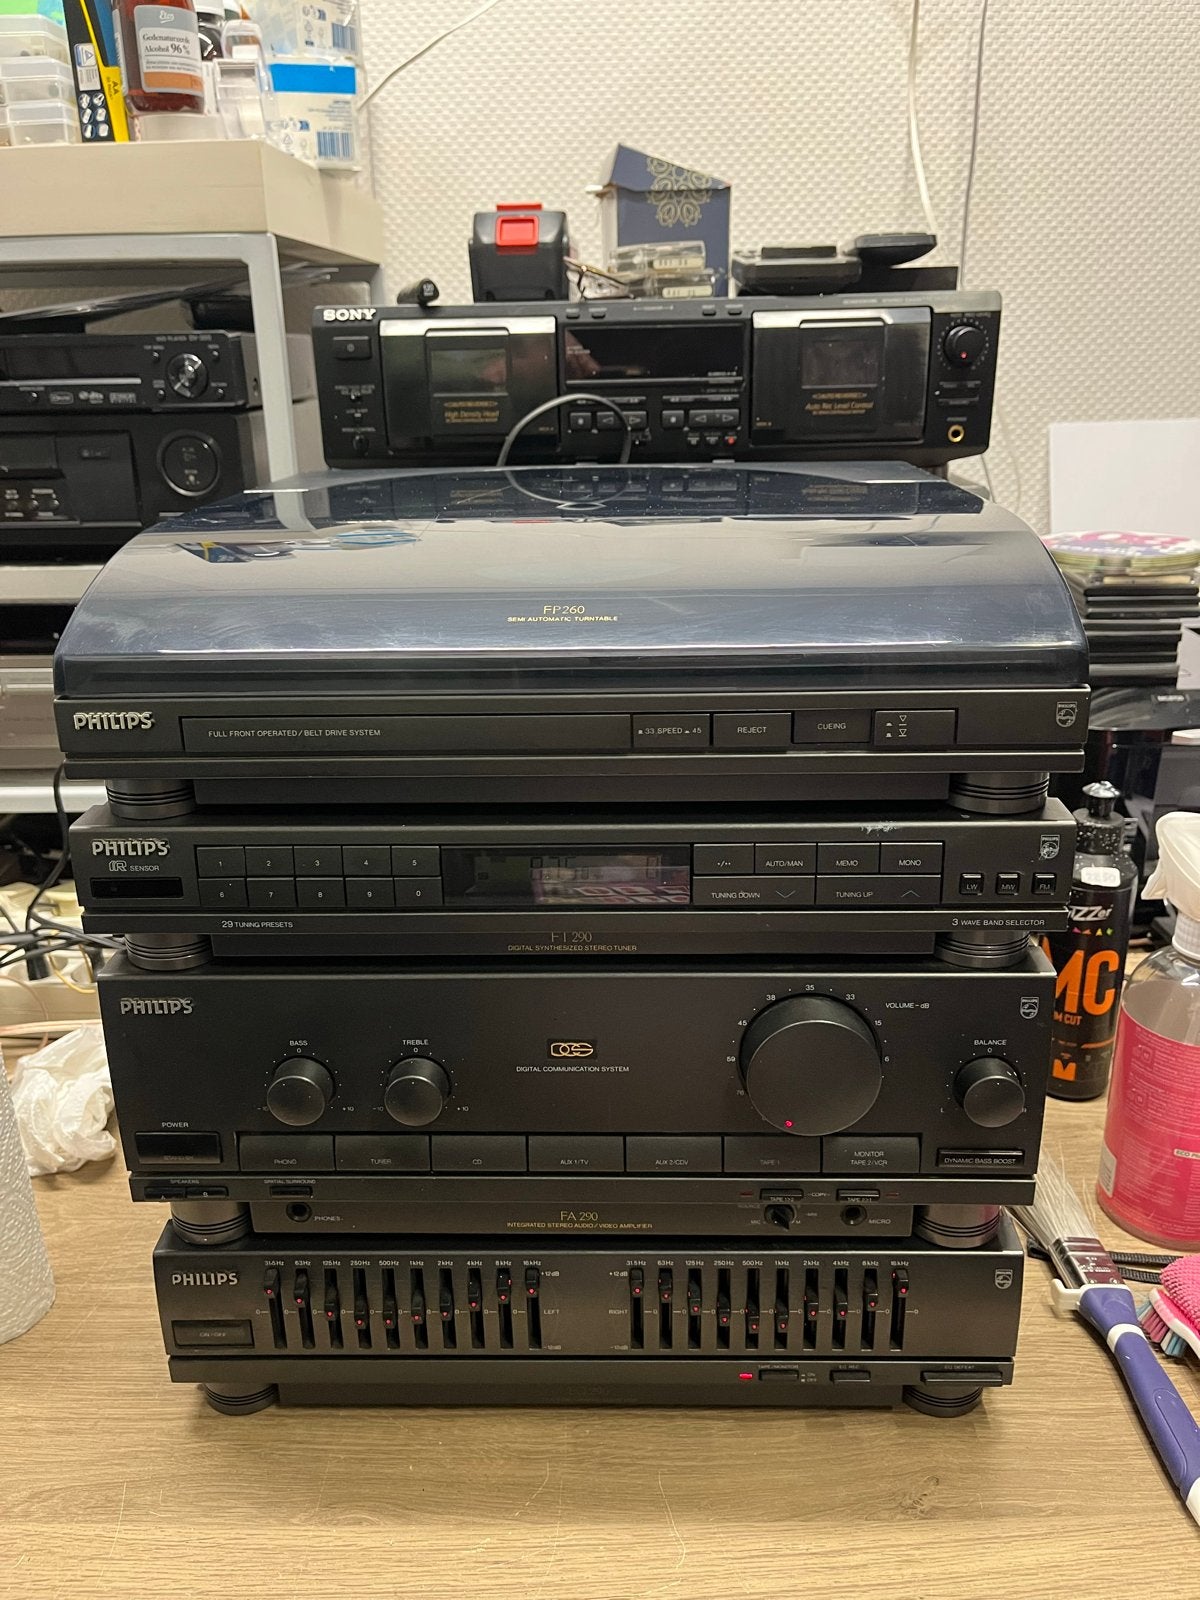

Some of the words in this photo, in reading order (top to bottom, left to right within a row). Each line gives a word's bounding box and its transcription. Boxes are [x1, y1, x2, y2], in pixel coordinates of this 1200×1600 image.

[145, 45, 169, 53] Alcohol
[323, 309, 376, 321] SONY
[543, 605, 585, 615] FP260
[73, 712, 152, 730] PHILIPS
[817, 722, 846, 730] CUEING
[208, 730, 228, 738] FULL
[325, 729, 348, 737] DRIVE
[737, 726, 767, 734] REJECT
[91, 839, 170, 856] PHILIPS
[221, 920, 233, 928] 29
[952, 918, 958, 926] 3
[572, 932, 592, 942] 290
[120, 997, 194, 1015] PHILIPS
[1064, 1013, 1083, 1026] CUT
[560, 1211, 577, 1221] FA
[579, 1211, 599, 1221] 290
[172, 1271, 240, 1286] PHILIPS
